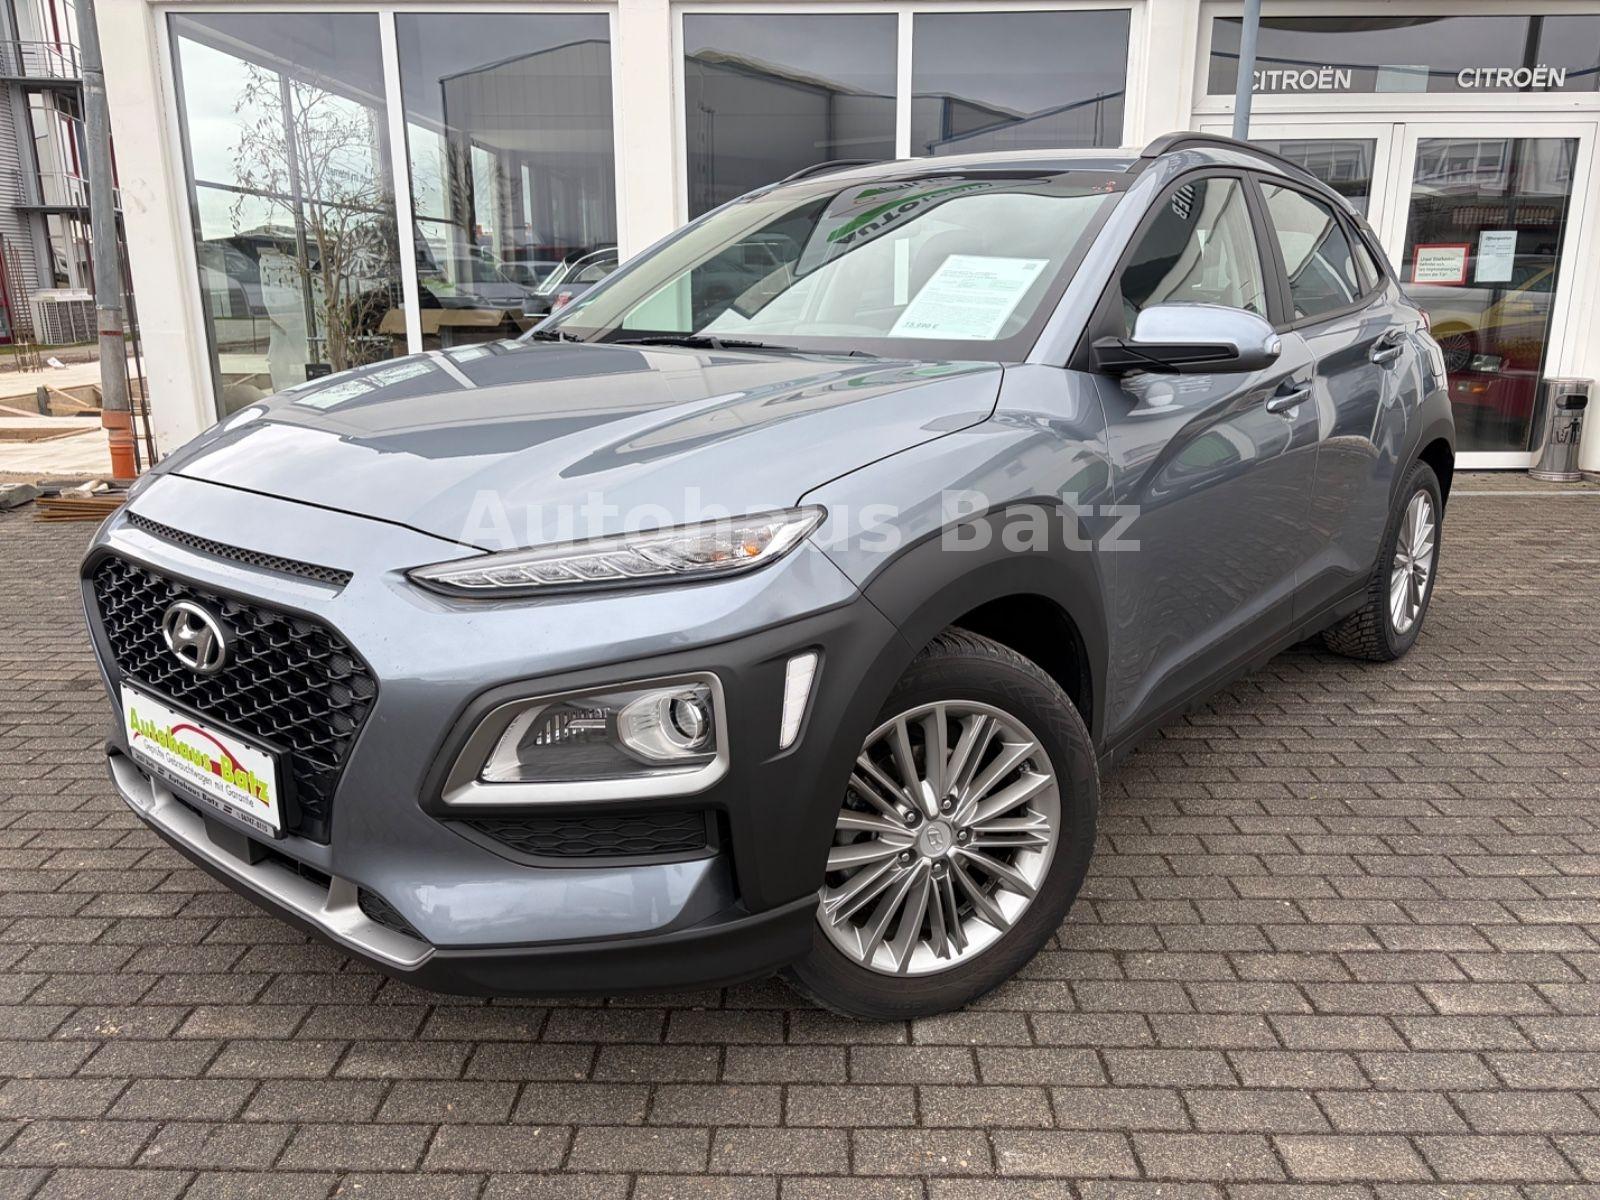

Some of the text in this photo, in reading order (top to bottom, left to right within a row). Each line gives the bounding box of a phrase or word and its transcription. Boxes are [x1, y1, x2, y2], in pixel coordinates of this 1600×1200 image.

[1457, 65, 1566, 88] CITROËN
[130, 706, 270, 802] Autohaus Batz
